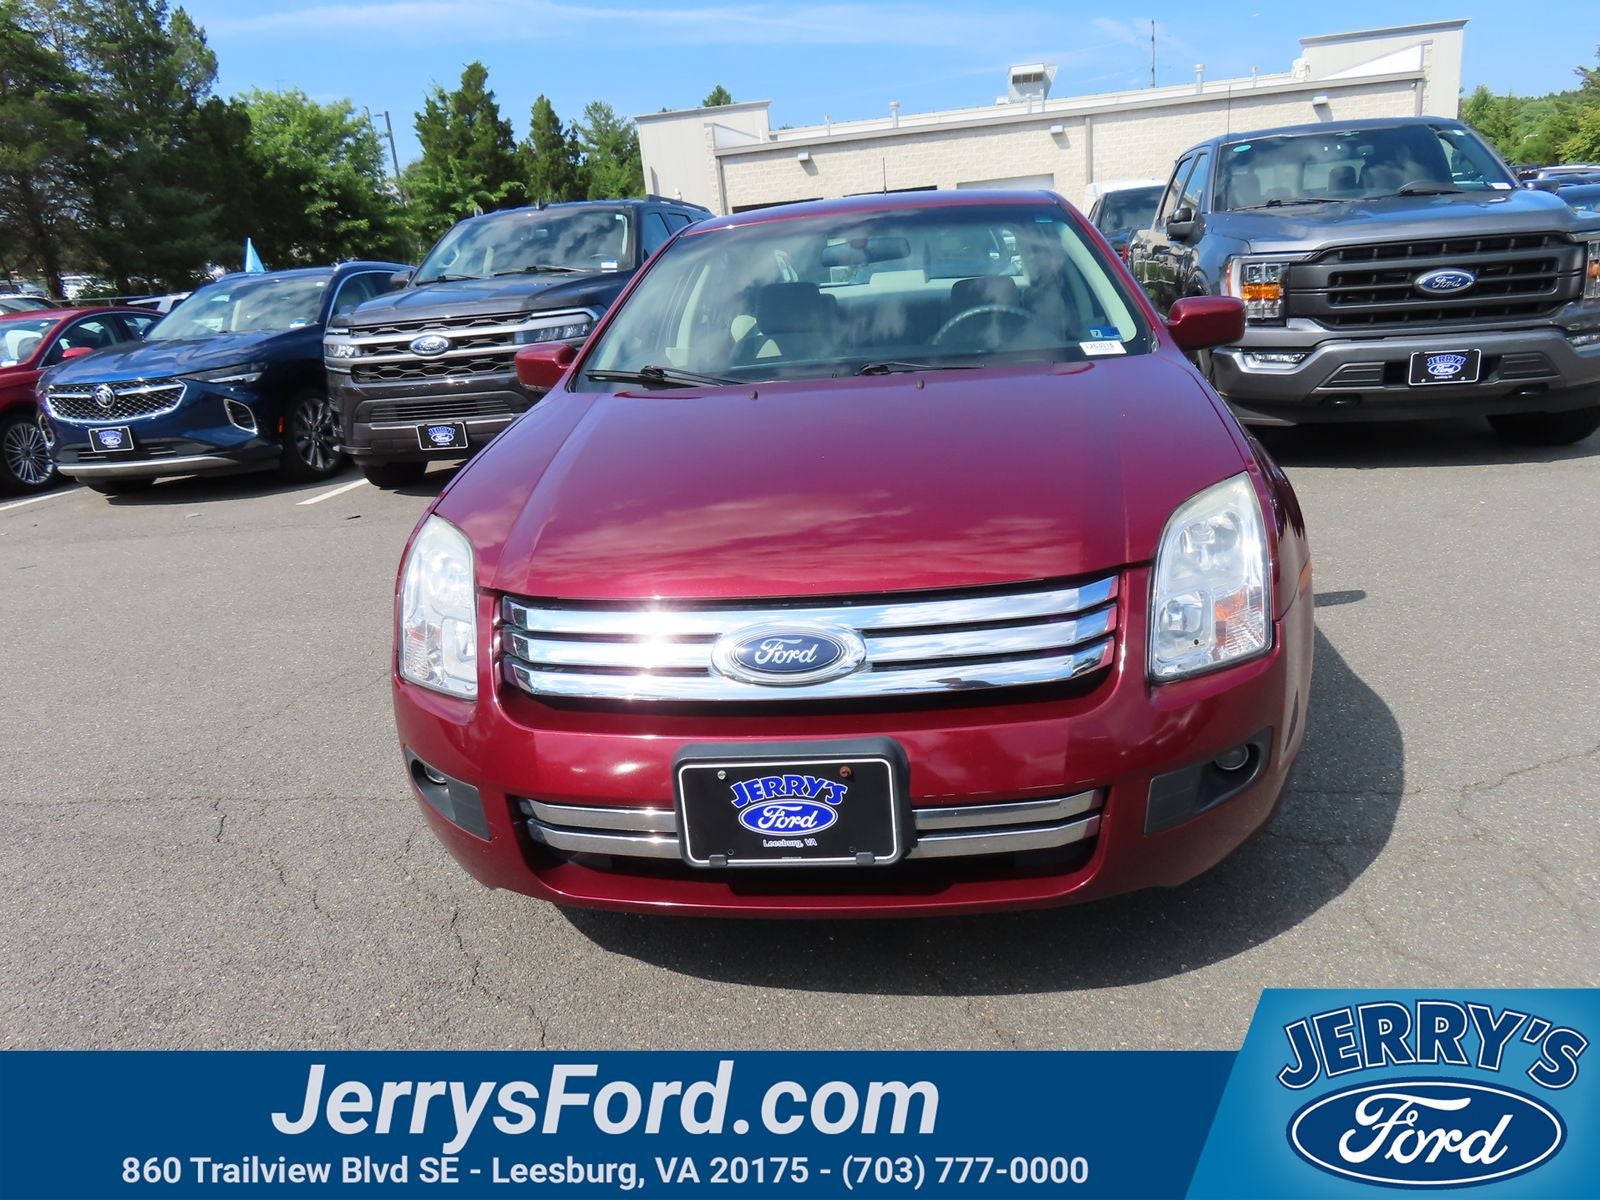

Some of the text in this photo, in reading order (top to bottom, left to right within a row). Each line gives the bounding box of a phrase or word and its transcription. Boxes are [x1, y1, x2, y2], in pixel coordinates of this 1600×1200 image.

[1432, 275, 1462, 289] Ford
[754, 638, 819, 665] Ford
[730, 774, 848, 808] JERRY'S
[757, 804, 819, 829] Ford
[763, 838, 818, 848] Leesburg, VA
